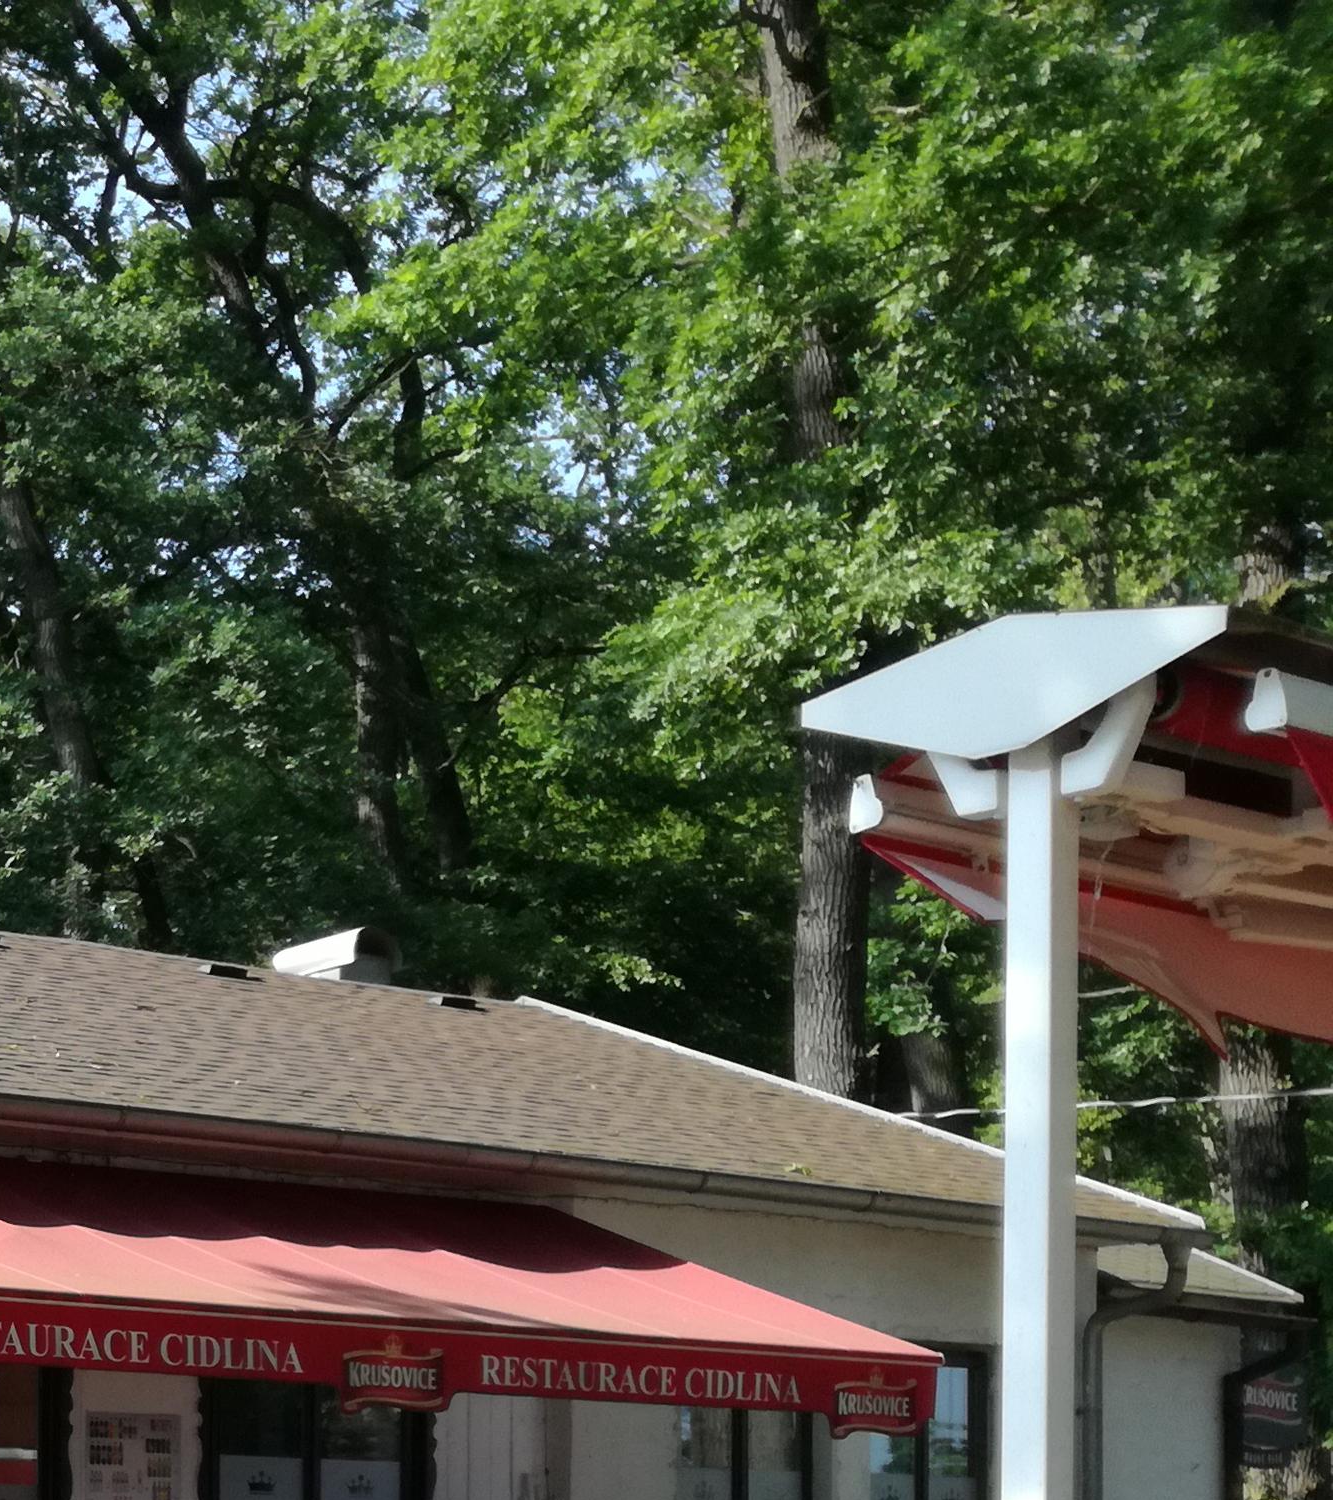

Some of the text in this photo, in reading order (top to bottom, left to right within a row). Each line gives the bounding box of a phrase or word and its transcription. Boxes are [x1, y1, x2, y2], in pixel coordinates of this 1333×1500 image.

[160, 1332, 304, 1374] CIDLINA
[348, 1360, 438, 1391] KRUŠOVICE
[480, 1353, 802, 1405] RESTAURACE CIDLINA
[837, 1390, 911, 1418] KRUŠOVICE
